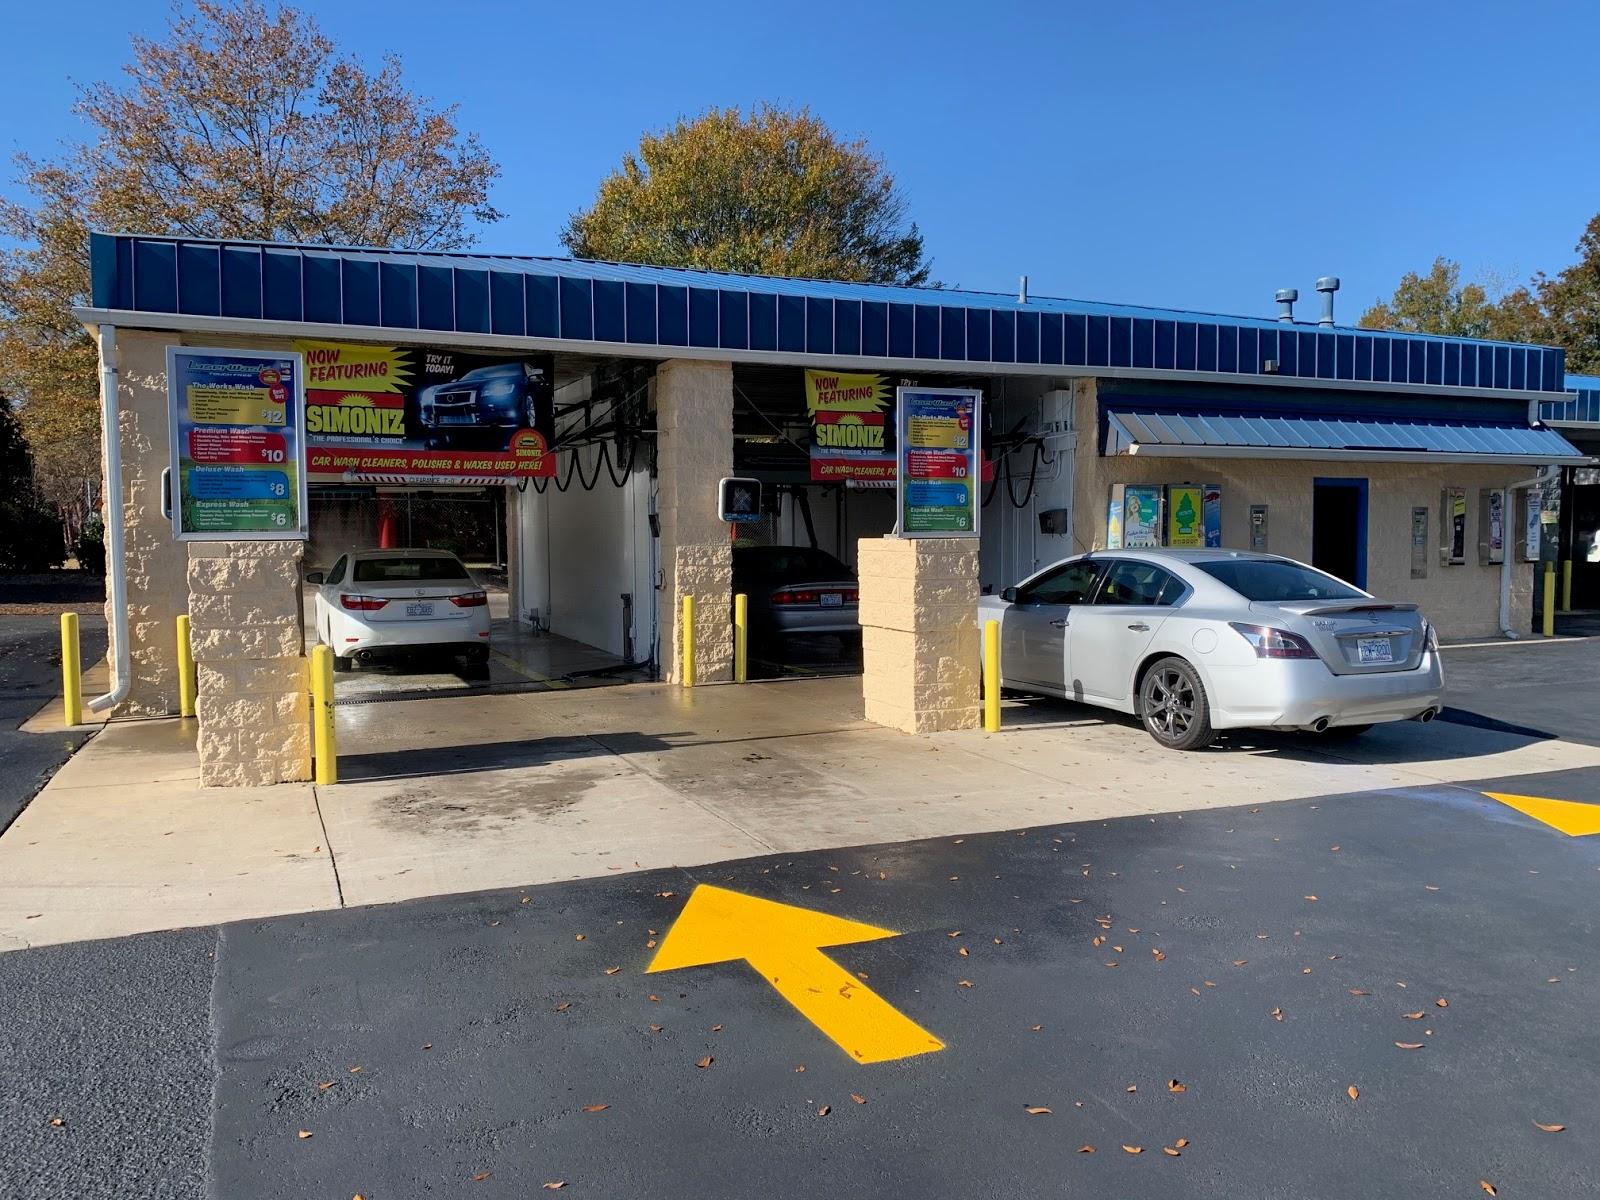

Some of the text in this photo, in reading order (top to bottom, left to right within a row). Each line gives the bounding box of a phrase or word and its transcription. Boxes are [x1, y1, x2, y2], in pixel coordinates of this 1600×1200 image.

[306, 349, 340, 366] NOW
[426, 354, 452, 365] TRY IT
[309, 361, 388, 382] FEATURING
[425, 364, 454, 375] TODAY!
[209, 382, 233, 390] Works
[815, 376, 839, 389] NOW
[817, 386, 873, 405] FEATURING
[306, 405, 405, 435] SIMONIZ
[194, 427, 251, 435] Premium Wash
[815, 423, 885, 448] SIMONIZ
[262, 449, 284, 462] $10
[195, 465, 222, 473] Deluxe
[311, 456, 543, 471] CAR WASH CLEANERS, POLISHES & WAXES USED HERE!
[952, 466, 966, 478] $10
[270, 483, 285, 496] $8
[196, 501, 226, 509] Express
[956, 493, 966, 504] $8
[271, 512, 286, 526] $6
[957, 516, 966, 527] $6
